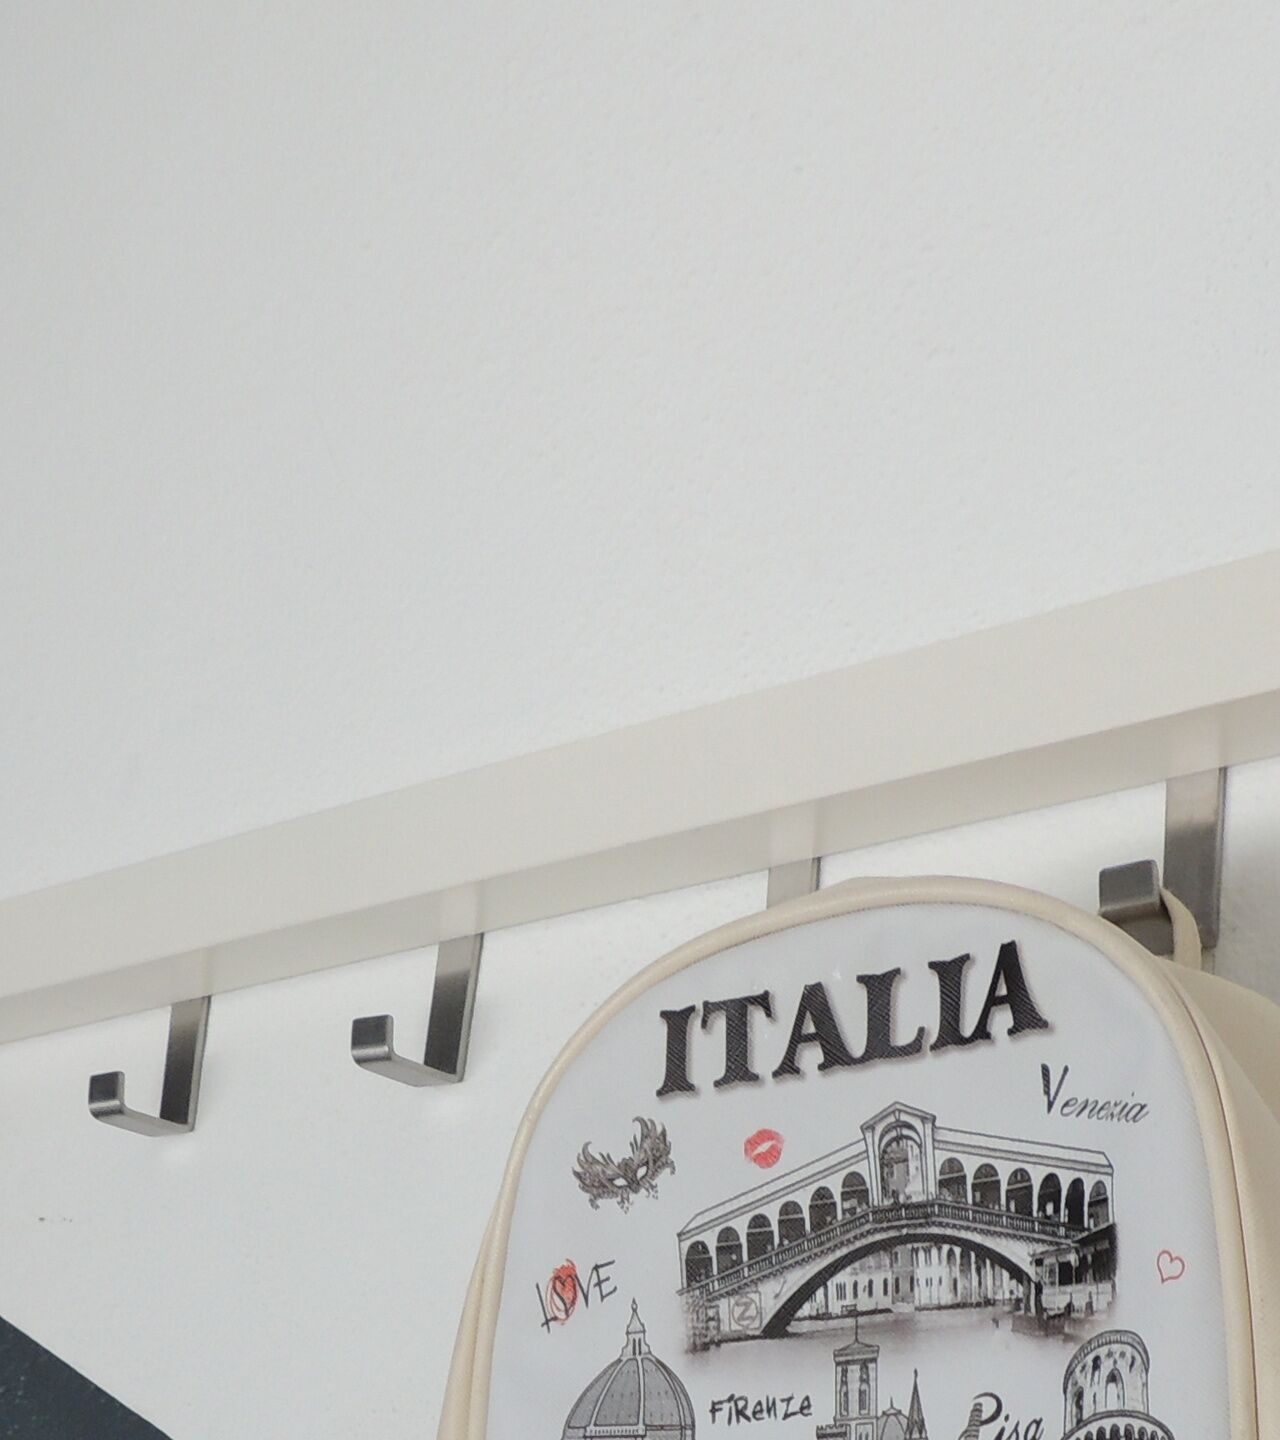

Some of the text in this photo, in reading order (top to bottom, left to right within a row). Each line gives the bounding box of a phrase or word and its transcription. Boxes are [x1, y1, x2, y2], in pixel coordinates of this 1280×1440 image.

[656, 939, 1050, 1098] ITALIA
[1041, 1063, 1150, 1124] Venezia
[535, 1258, 618, 1334] LOVE
